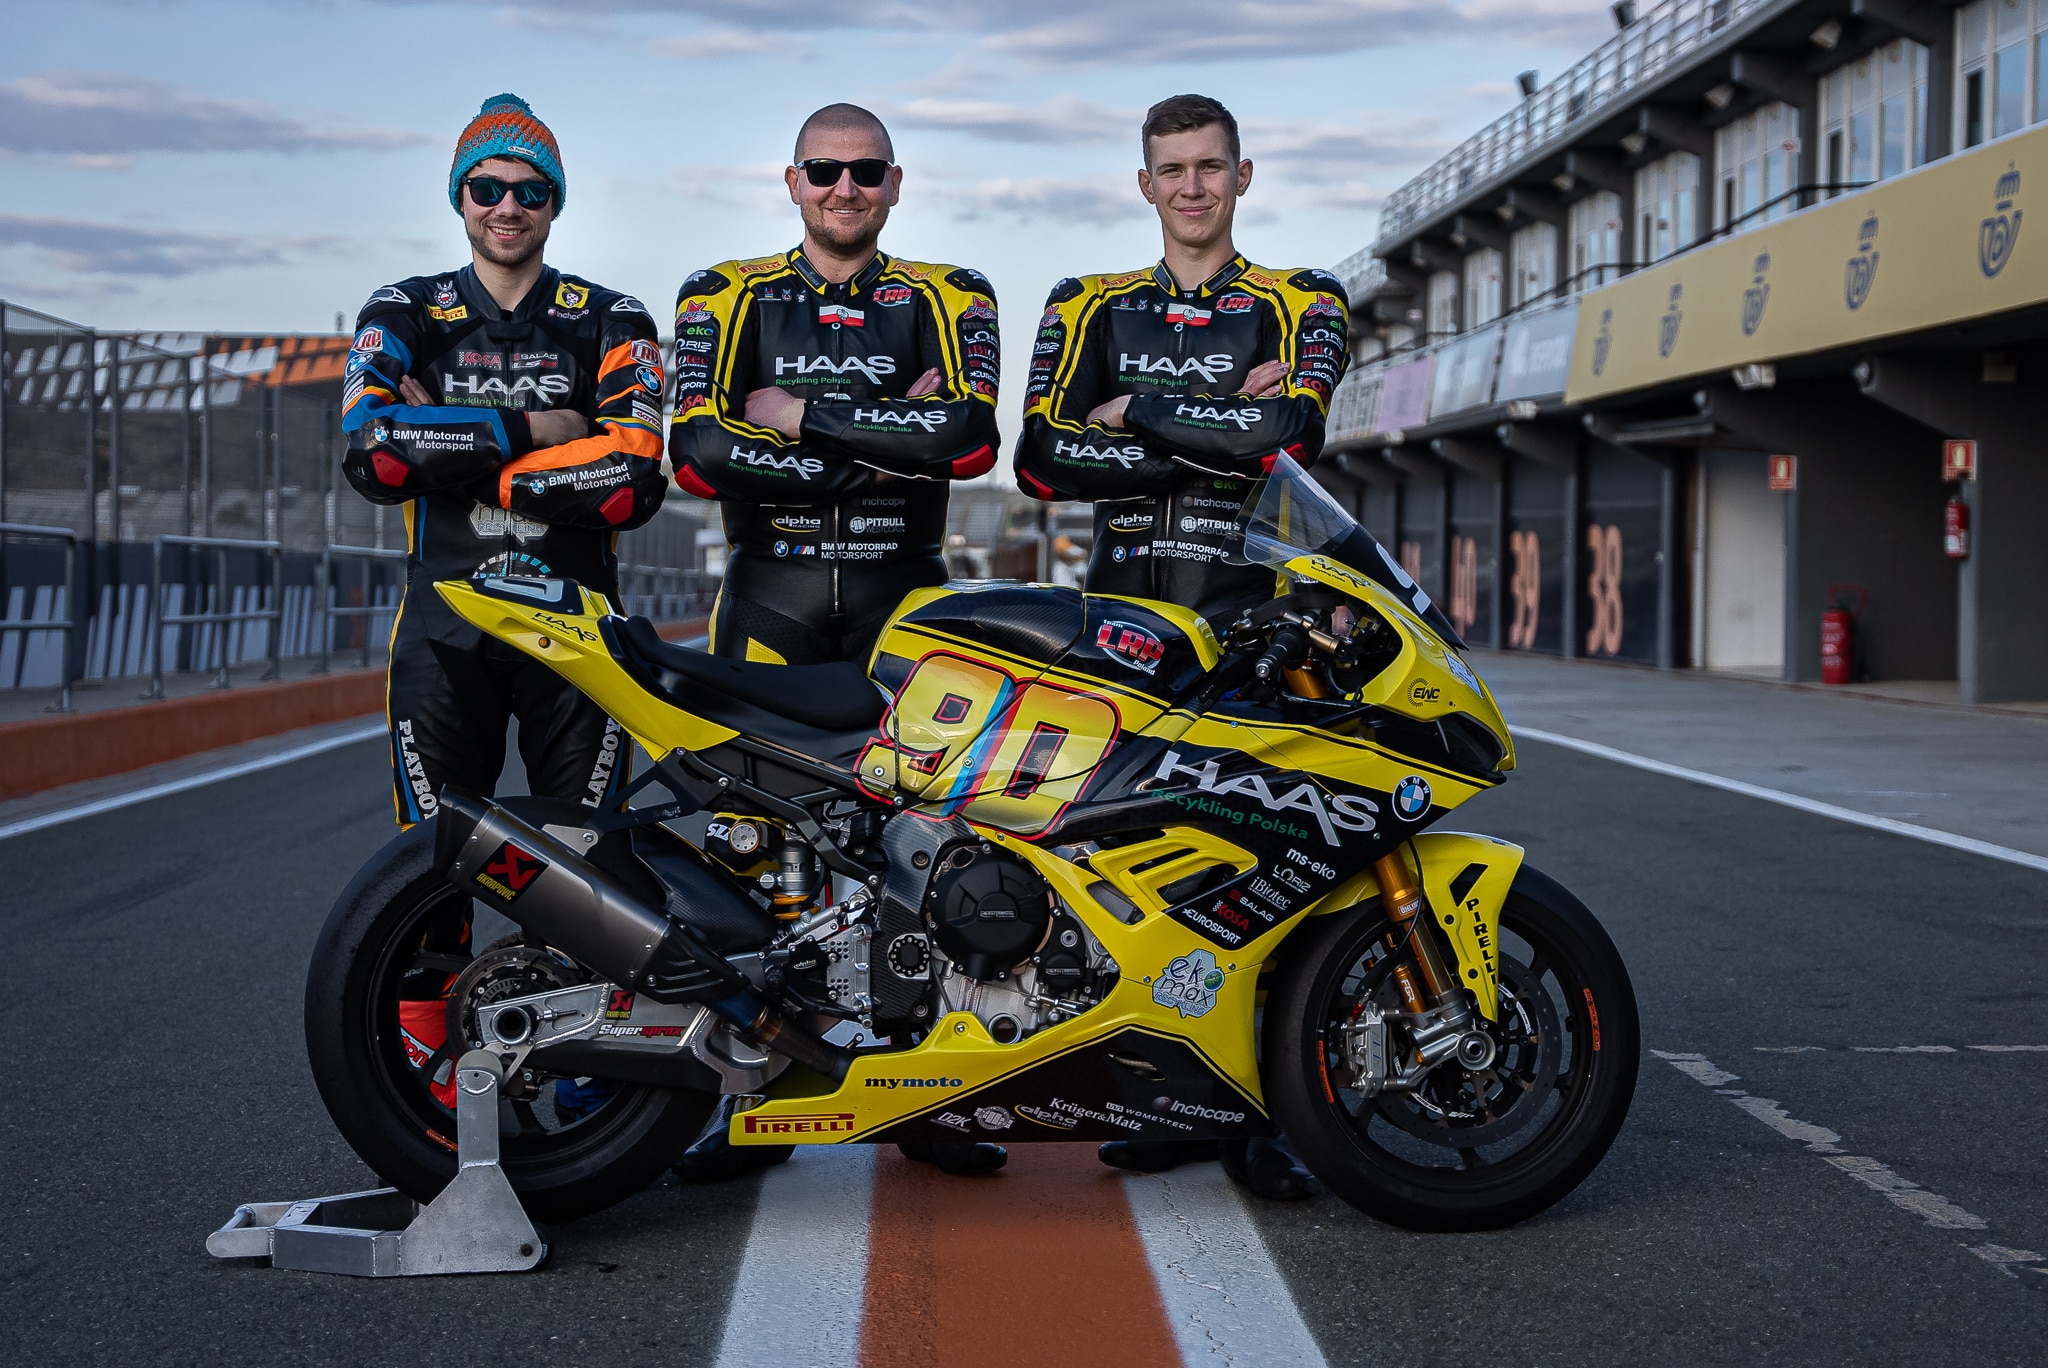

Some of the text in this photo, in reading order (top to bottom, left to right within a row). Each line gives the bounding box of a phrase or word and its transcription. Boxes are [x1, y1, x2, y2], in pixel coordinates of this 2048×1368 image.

[873, 289, 912, 302] LRP
[1216, 296, 1256, 310] LRP
[676, 338, 712, 350] ORIZ
[679, 371, 707, 379] ALAG
[775, 355, 897, 385] HAAS
[1119, 353, 1235, 384] HAAS
[444, 372, 570, 405] HAAS
[680, 381, 708, 391] SPORT
[775, 376, 819, 387] Recykling
[1118, 375, 1159, 386] Recykling
[445, 395, 492, 407] Recykling
[853, 408, 948, 433] HAAS
[1173, 416, 1228, 430] Recykling Polska
[1176, 403, 1262, 431] HAAS
[392, 430, 474, 442] BMW Motorrad
[853, 422, 913, 434] Recykling Polska
[415, 439, 474, 451] Motorsport
[1054, 439, 1145, 469] HAAS
[728, 461, 788, 479] Recykling Polska
[730, 445, 824, 481] HAAS
[1053, 455, 1110, 469] Recykling Polska
[548, 461, 629, 487] BMW Motorrad
[574, 471, 632, 491] Motorsport
[775, 515, 821, 527] alpha
[866, 517, 905, 527] PITBULL
[1112, 513, 1153, 527] alpha
[848, 542, 899, 552] MOTORRAD
[1152, 540, 1175, 549] BMW
[821, 551, 884, 560] MOTORSPORT
[1152, 548, 1213, 563] MOTORSPORT
[1510, 530, 1541, 649] 39
[1587, 524, 1624, 656] 38
[534, 612, 599, 642] HAAS
[1095, 624, 1165, 662] LRP
[1133, 659, 1156, 675] Poland
[1413, 687, 1440, 700] EWC
[852, 649, 1124, 842] 90
[581, 717, 622, 808] LAYBOY
[1155, 750, 1380, 848] HAAS
[1151, 788, 1309, 840] Recykling Polska
[1286, 848, 1337, 880] ms-eko
[1273, 864, 1312, 893] LORIZ
[1250, 876, 1292, 909] iBiotec
[1239, 897, 1275, 922] SALAG
[1184, 908, 1242, 945] EUROSPORT
[1465, 897, 1498, 986] PIRELLI
[1160, 977, 1214, 1007] max
[599, 1023, 683, 1039] Supersprox
[865, 1077, 964, 1090] mymoto
[744, 1112, 856, 1134] PIRELLI
[937, 1112, 972, 1128] D2K
[1020, 1105, 1078, 1125] alpha
[1040, 1116, 1075, 1128] RACING
[1049, 1097, 1143, 1131] Krüger&Matz
